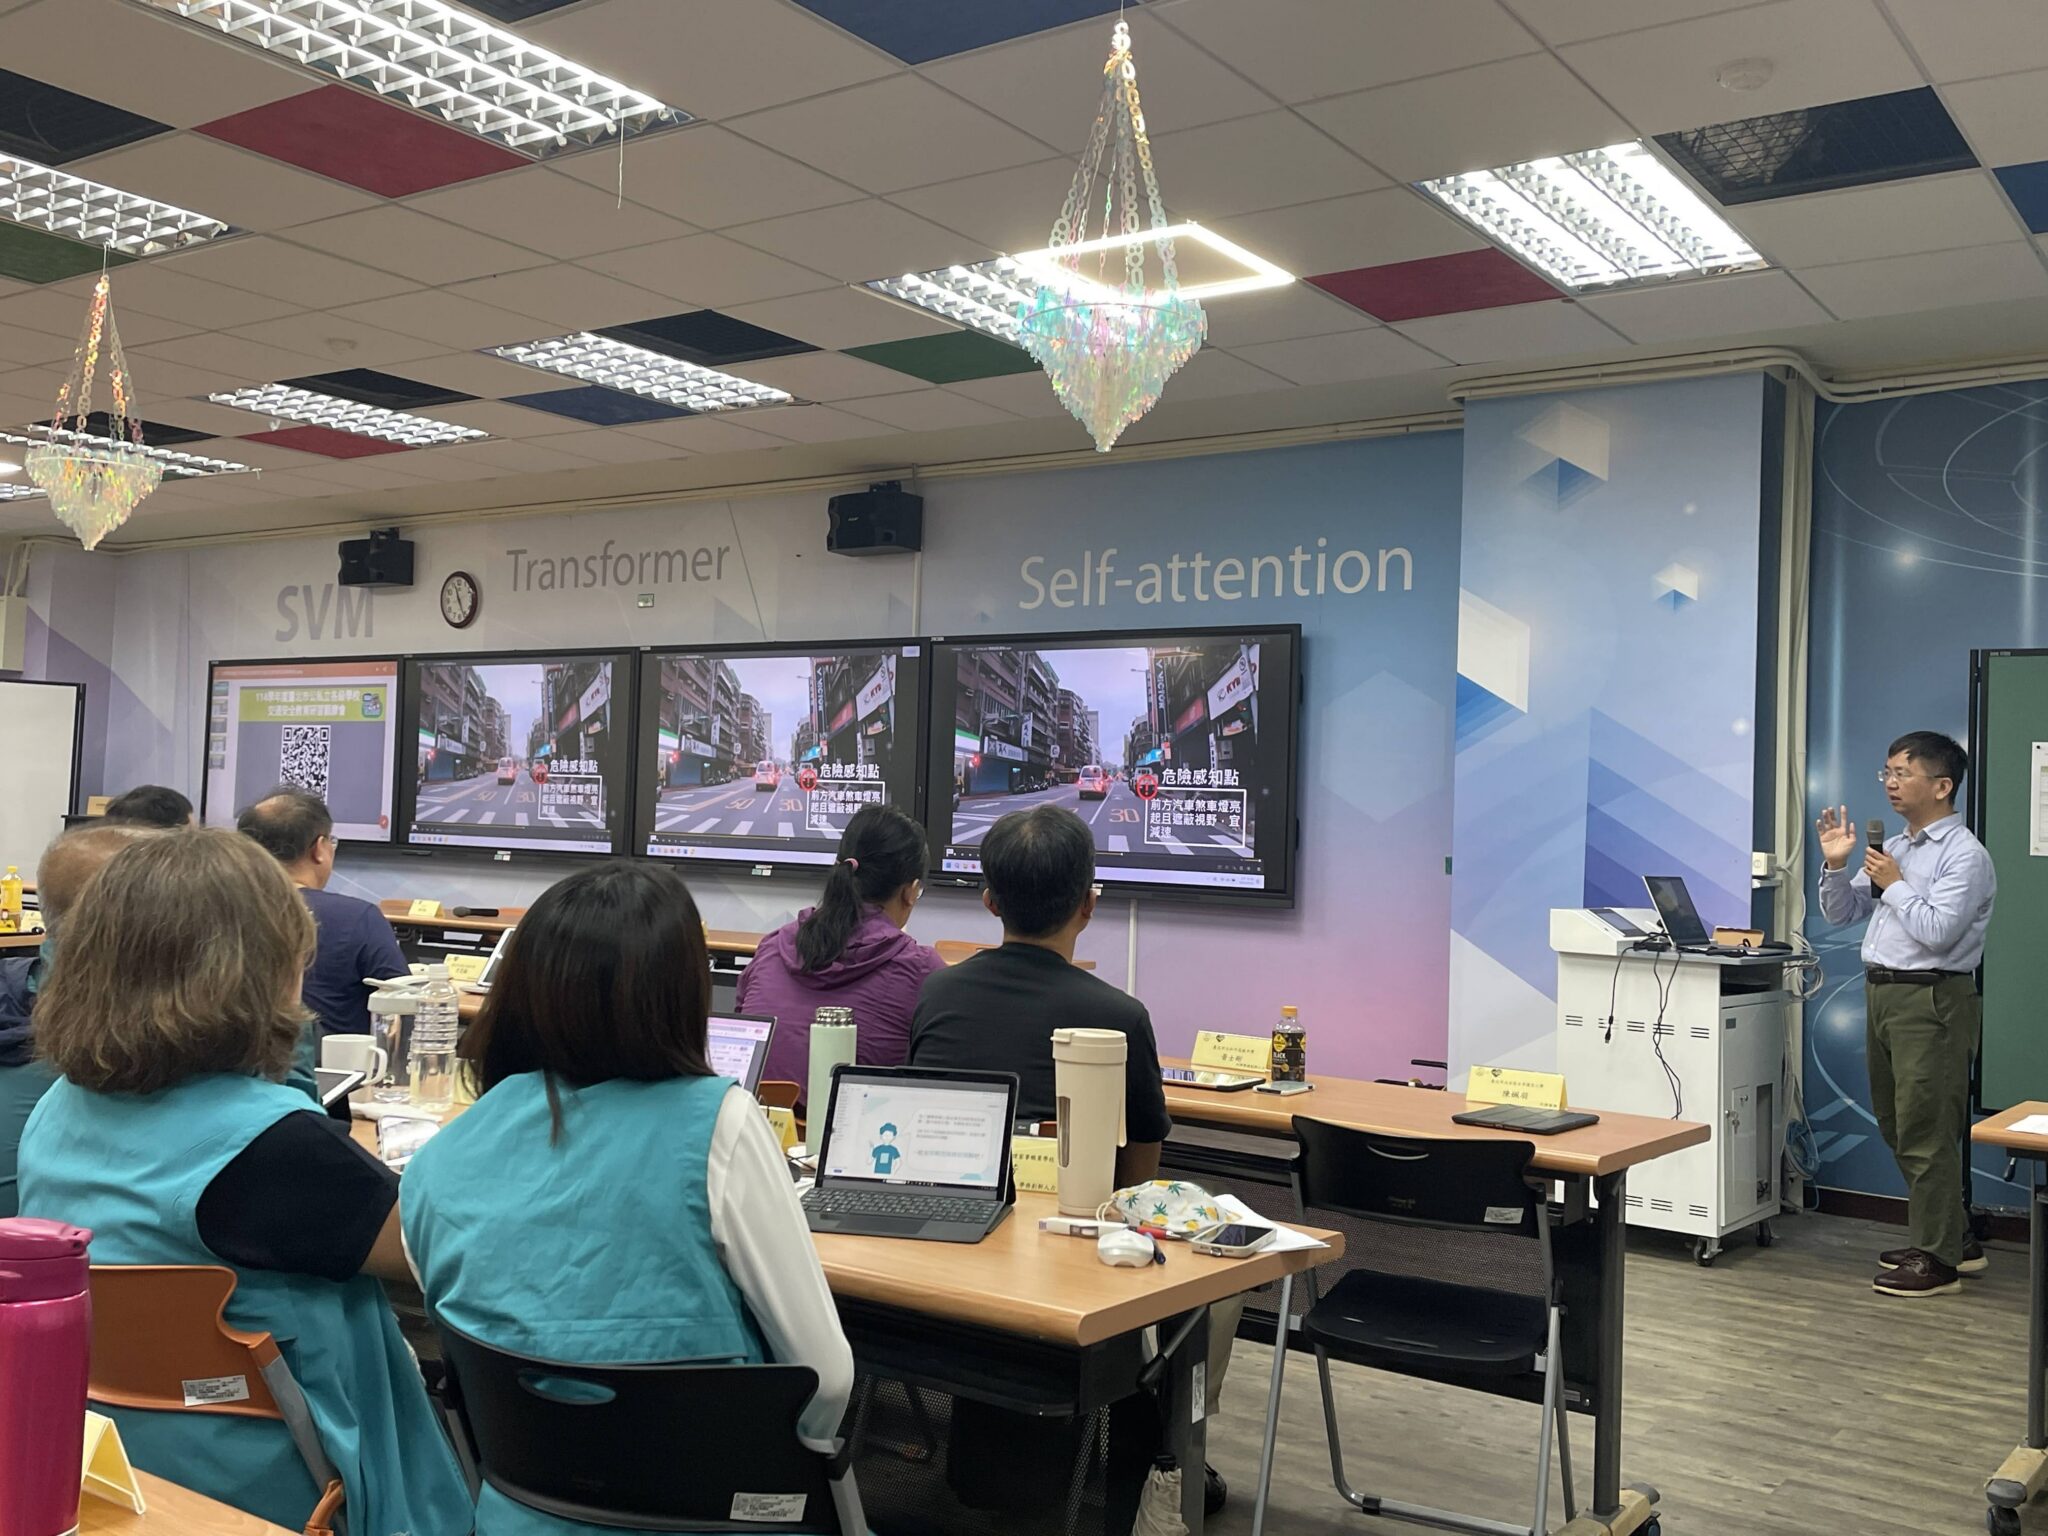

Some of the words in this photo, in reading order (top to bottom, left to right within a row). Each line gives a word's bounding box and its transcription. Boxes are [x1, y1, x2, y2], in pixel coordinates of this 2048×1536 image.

[506, 539, 730, 592] Transformer
[1019, 537, 1413, 610] Self-attention
[275, 584, 373, 642] SVM
[820, 763, 880, 779] 危險感知點
[1161, 768, 1240, 786] 危險感知點
[1150, 798, 1241, 813] 前方汽車煞車燈亮
[1109, 808, 1141, 823] 30
[1149, 825, 1173, 839] 減速
